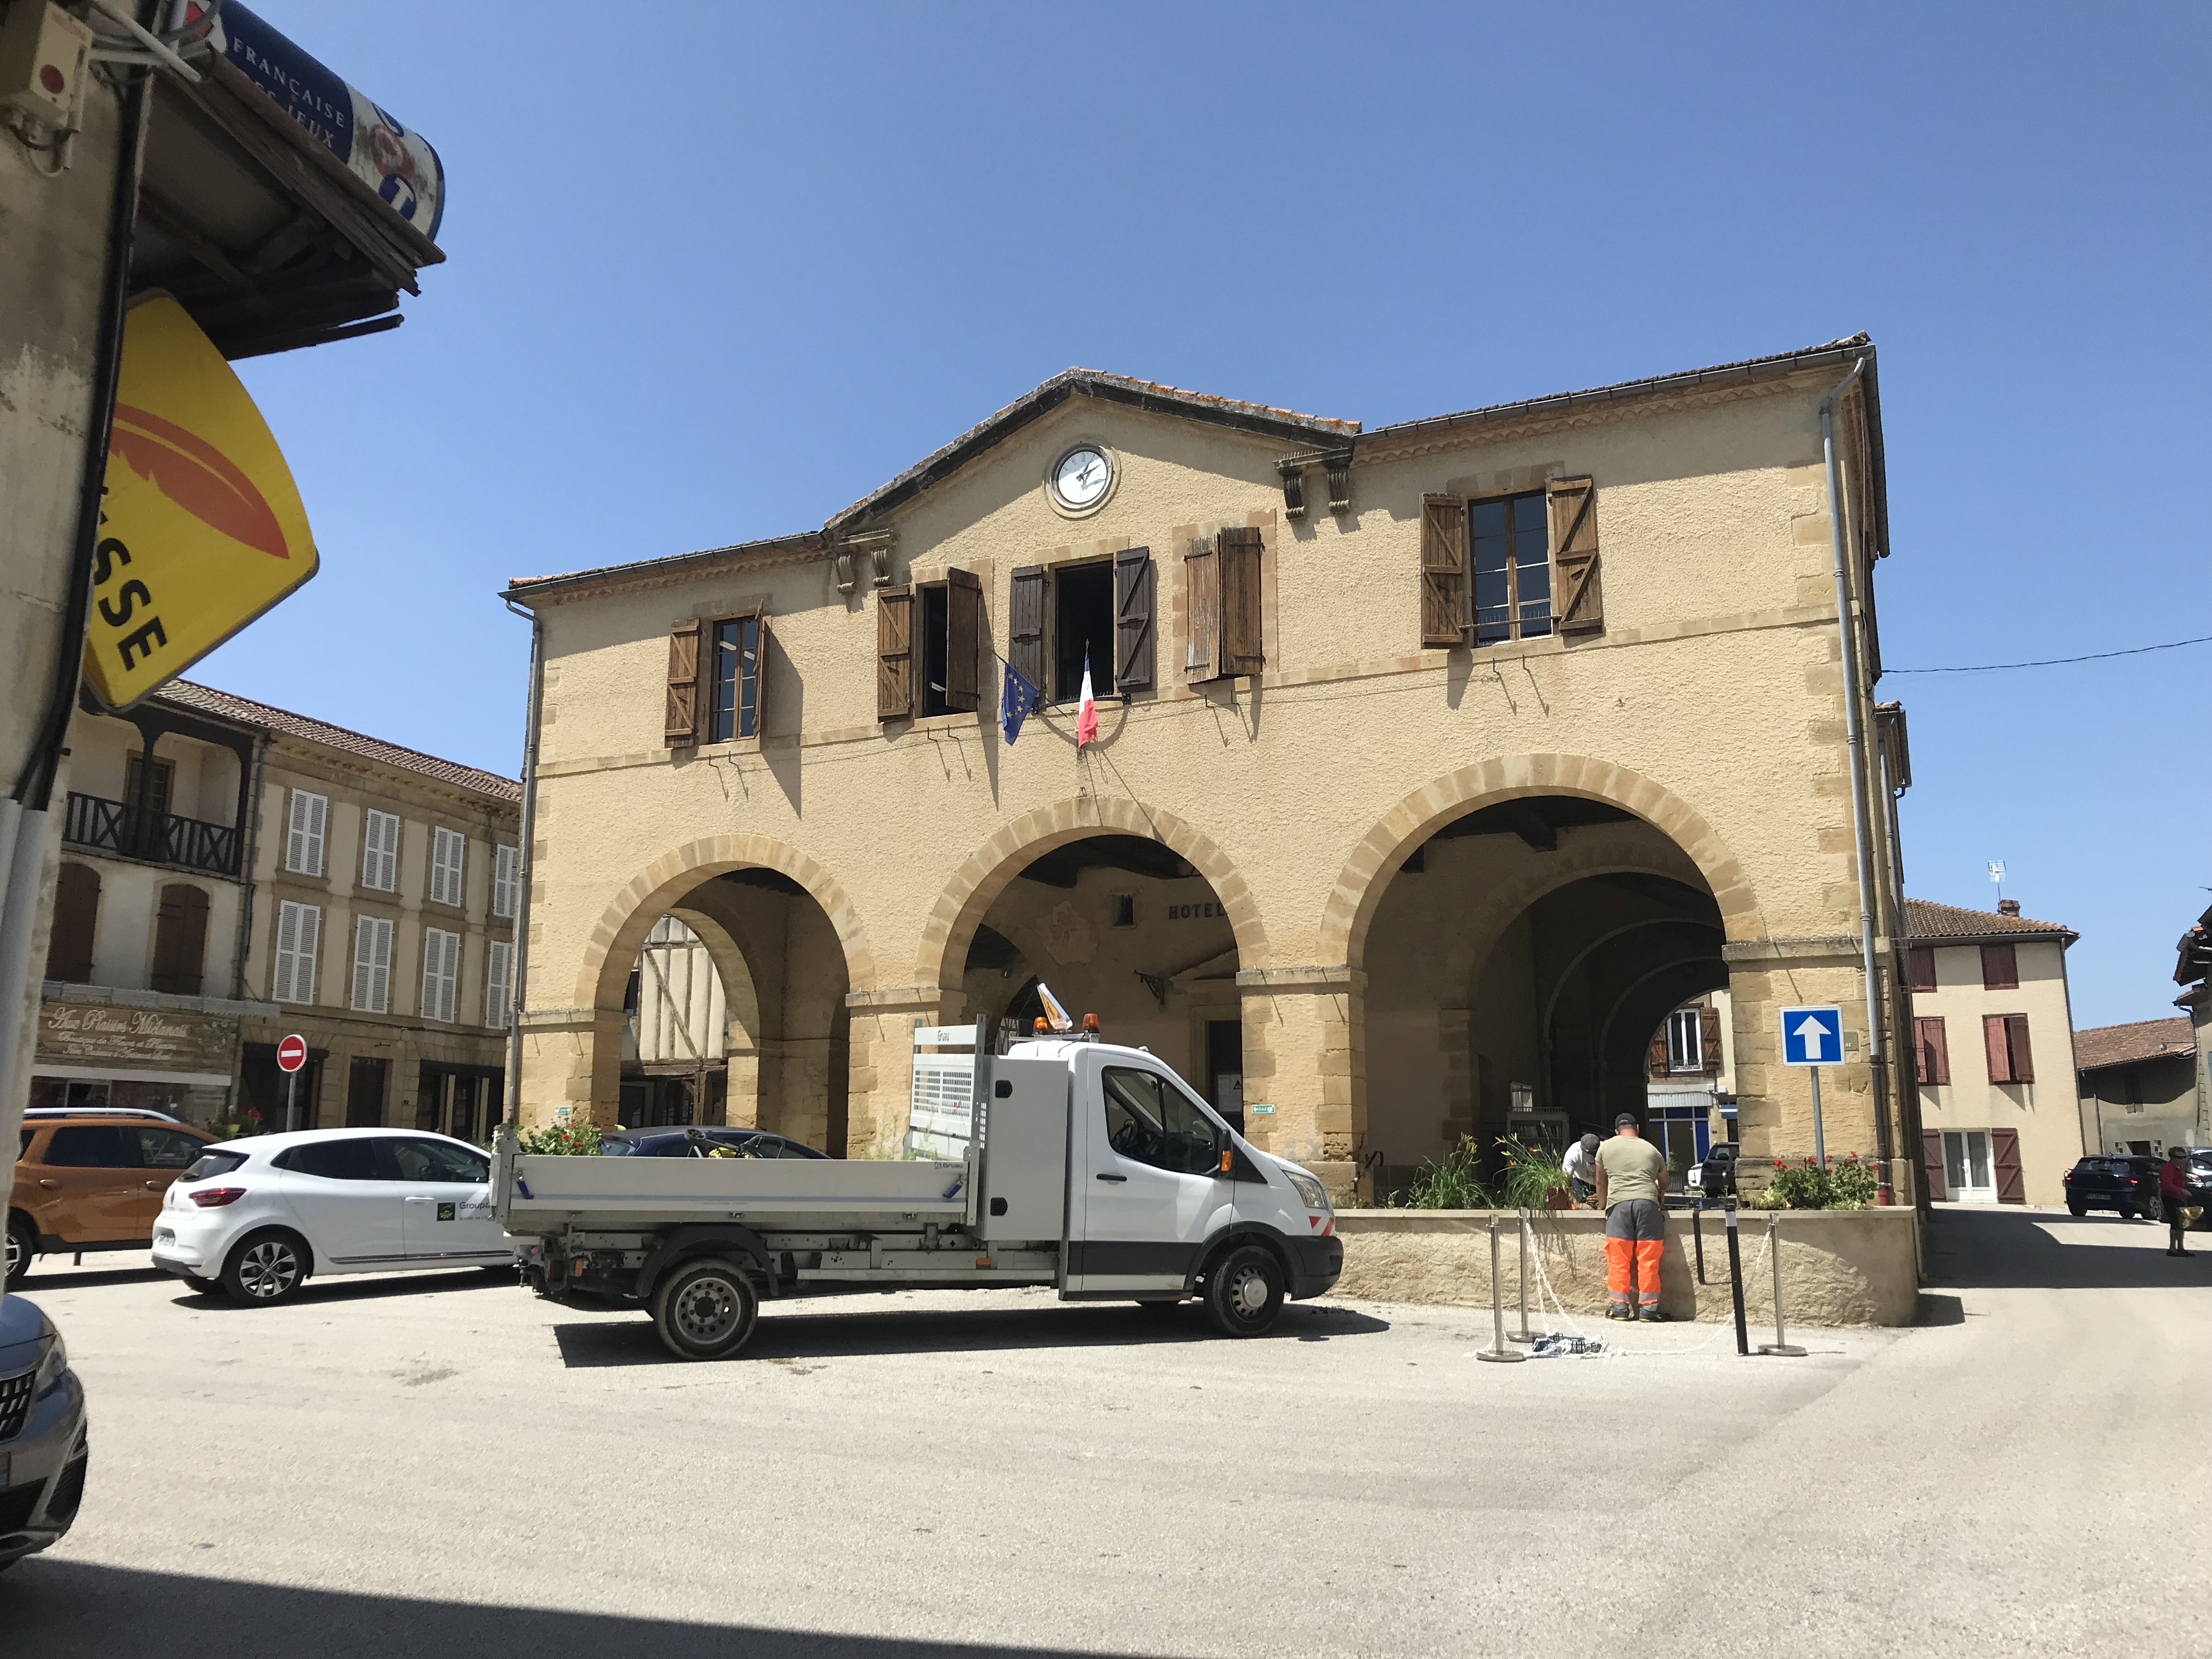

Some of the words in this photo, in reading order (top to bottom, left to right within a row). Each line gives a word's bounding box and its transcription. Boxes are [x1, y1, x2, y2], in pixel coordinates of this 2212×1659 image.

[233, 36, 345, 128] FRANÇAISE
[94, 511, 168, 672] SSE
[48, 1007, 81, 1029] Aux
[82, 1010, 127, 1032] Plaisirs
